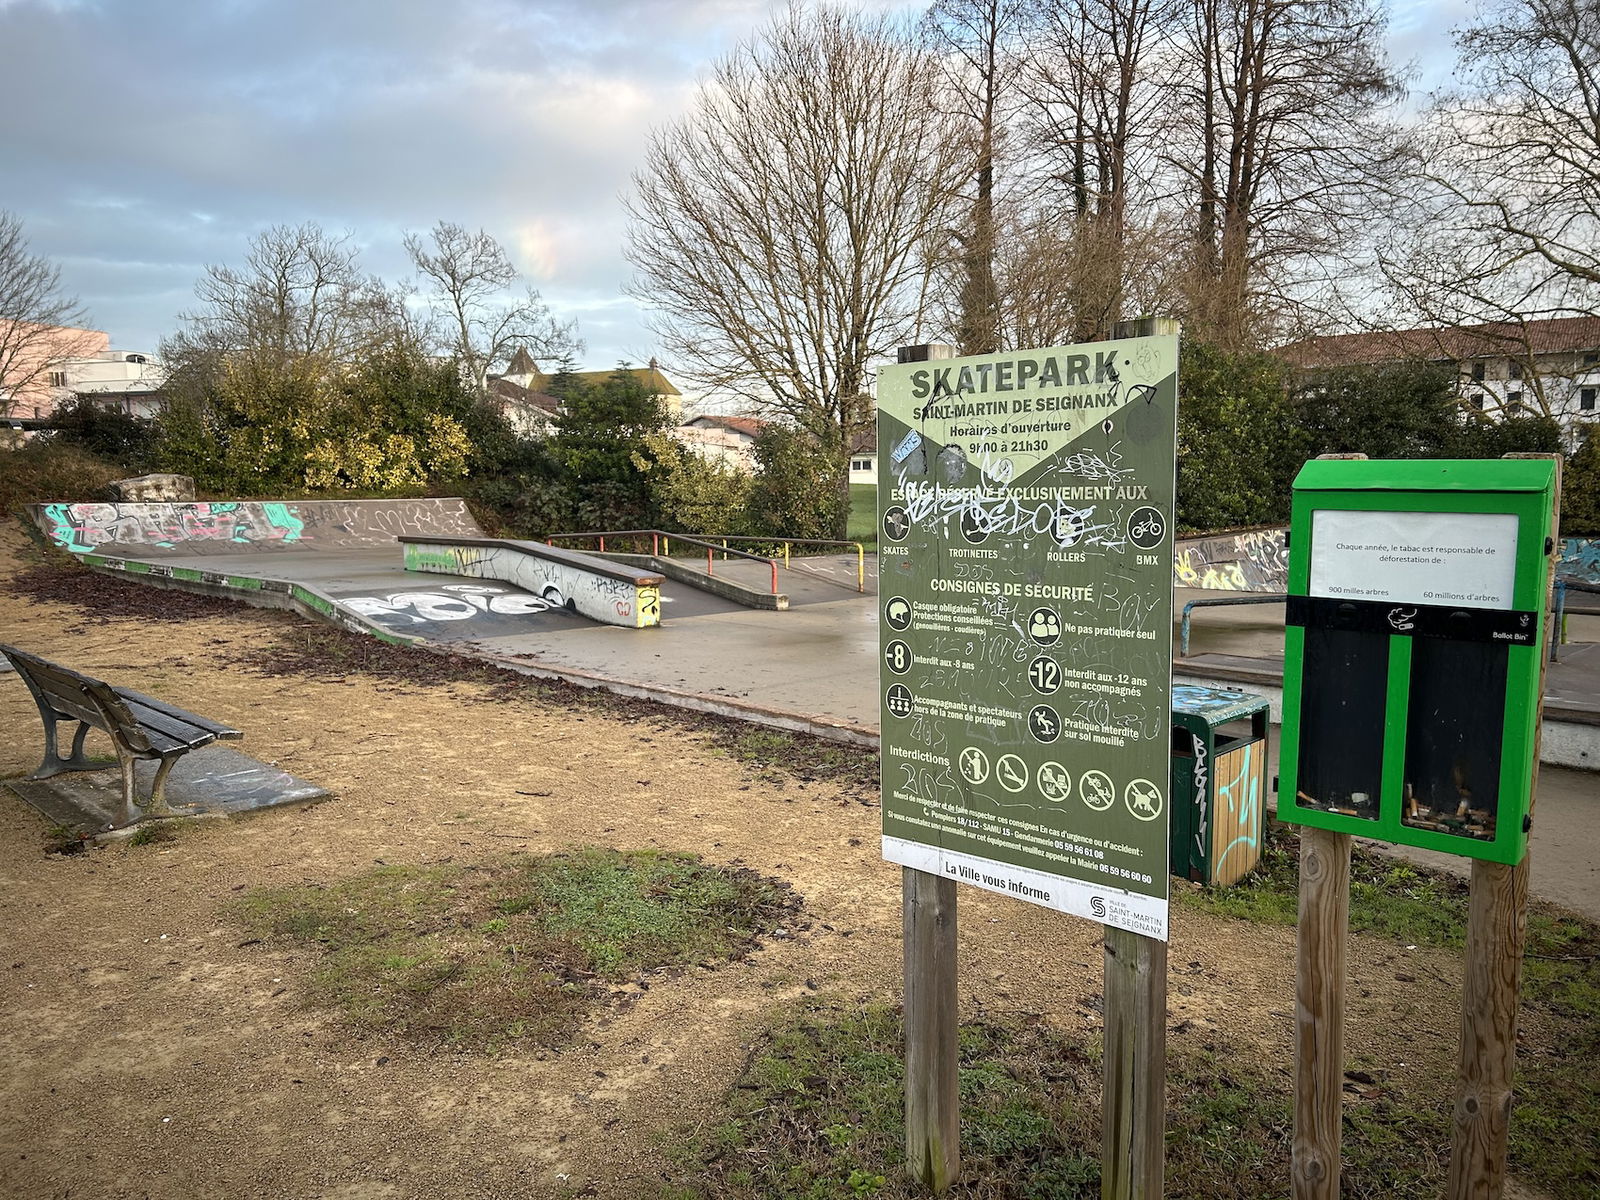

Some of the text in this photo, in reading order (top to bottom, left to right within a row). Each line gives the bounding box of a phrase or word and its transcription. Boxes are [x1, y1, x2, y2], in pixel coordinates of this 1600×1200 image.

[911, 350, 1118, 399] SKATEPARK
[913, 392, 1118, 420] SINT-MARTIN DE SEIGNANX
[950, 421, 1071, 437] Horaires d'ouverture
[1000, 440, 1008, 452] à
[1010, 440, 1049, 452] 21h30
[891, 487, 935, 501] ESACE
[998, 486, 1113, 500] EXCLUSIVEMENT
[1115, 485, 1148, 500] AUX
[883, 546, 909, 555] SKATES
[948, 548, 998, 559] TROTINETTES
[1047, 552, 1086, 562] ROLLERS
[1336, 543, 1363, 551] Chaque
[1364, 544, 1389, 552] année,
[1391, 544, 1398, 552] le
[1435, 547, 1484, 555] responsable
[1485, 547, 1496, 555] de
[1136, 555, 1159, 565] BMX
[1379, 555, 1430, 564] déforestation
[1431, 556, 1442, 564] de
[930, 578, 1093, 601] CONSIGNES DE SÉCURITÉ
[1343, 587, 1364, 595] milles
[1365, 588, 1389, 596] arbres
[1435, 592, 1465, 600] millions
[1466, 593, 1500, 602] d'arbres
[912, 601, 977, 615] Casque obligatoire
[912, 610, 994, 626] Protections conseillées
[1064, 622, 1156, 640] Ne pas pratiquer seul
[1492, 631, 1513, 640] Ballot
[913, 654, 975, 671] Interdit aux -8 ans
[1064, 667, 1148, 687] Interdit aux -12 ans
[1064, 679, 1142, 697] non accompagnés
[913, 695, 1023, 720] Accompagnants et spectateurs
[913, 703, 1006, 728] hors de la zone de pratique
[1064, 717, 1100, 732] Pratique
[1064, 729, 1125, 747] sur sol mouillé
[889, 744, 950, 767] Interdictions
[957, 816, 980, 829] 18/112
[983, 822, 1002, 834] SAMU
[1002, 827, 1011, 837] 15
[1014, 831, 1054, 848] Gendarmerie
[1054, 840, 1064, 850] 05
[1064, 842, 1074, 852] 59
[1084, 848, 1093, 857] 61
[969, 809, 997, 821] respecter
[997, 814, 1009, 824] ces
[1009, 818, 1040, 832] consignes
[1040, 824, 1048, 834] En
[1049, 828, 1060, 838] cas
[1093, 838, 1103, 847] ou
[1103, 840, 1140, 857] d'accident
[967, 831, 976, 840] sur
[977, 832, 987, 842] cet
[1045, 850, 1069, 864] appeler
[1069, 855, 1077, 865] la
[1077, 858, 1099, 871] Mairie
[1099, 863, 1109, 874] 05
[1110, 866, 1119, 876] 59
[1120, 868, 1130, 879] 56
[1131, 871, 1141, 882] 60
[1141, 874, 1152, 884] 60
[945, 861, 957, 875] La
[959, 864, 980, 882] Ville
[982, 873, 1006, 889] vous
[1008, 878, 1051, 902] informe
[1108, 905, 1162, 927] SAINT-MARTIN
[1108, 913, 1162, 936] DE SEIGNANX
